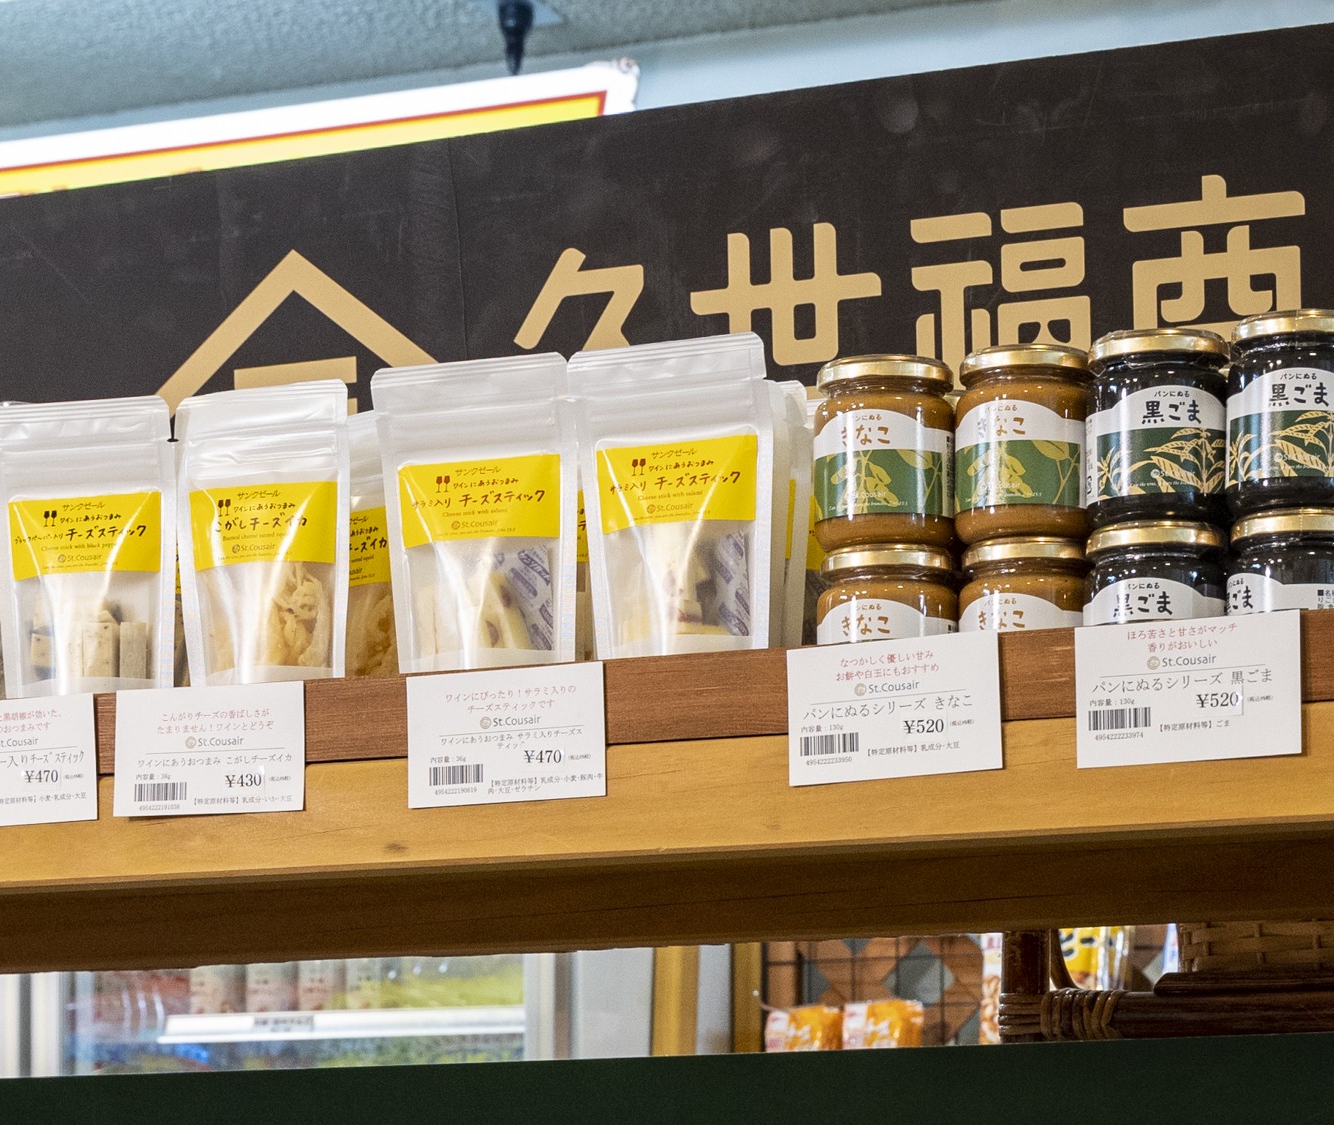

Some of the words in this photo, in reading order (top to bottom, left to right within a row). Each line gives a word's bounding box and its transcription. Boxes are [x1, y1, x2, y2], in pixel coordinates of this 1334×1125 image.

[1280, 372, 1318, 380] パンにぬる
[1154, 389, 1190, 398] パンにぬる
[1268, 382, 1329, 407] 黒ごま
[1141, 400, 1202, 425] 黒ごま
[455, 465, 501, 476] サンクゼール
[655, 470, 741, 490] チーズスティック
[458, 488, 546, 507] チーズスティック
[65, 524, 147, 541] チーズスティック
[1127, 623, 1238, 640] ほろ苦さと甘さがマッチ
[1148, 639, 1218, 653] 香りがおいしい
[840, 650, 934, 667] なつかしく優しい甘み
[1162, 654, 1217, 667] St.Cousair
[836, 663, 939, 682] お餅や白玉にもおすすめ
[868, 681, 920, 694] St.Cousair
[1092, 672, 1222, 693] パンにぬるシリーズ
[1230, 668, 1273, 685] 黒ごま
[803, 698, 926, 721] パンにぬるシリーズ
[935, 694, 973, 710] きなこ
[1196, 692, 1240, 709] ¥520
[493, 715, 541, 727] St.Cousair
[903, 719, 944, 735] ¥520
[197, 736, 244, 747] St.Cousair
[441, 733, 513, 745] ワインにあうおつまみ
[138, 756, 221, 767] ワインにあうおつまみ
[226, 753, 293, 765] こがしチーズイカ
[524, 749, 562, 764] ¥470
[25, 769, 59, 783] ¥470
[225, 773, 262, 788] ¥430
